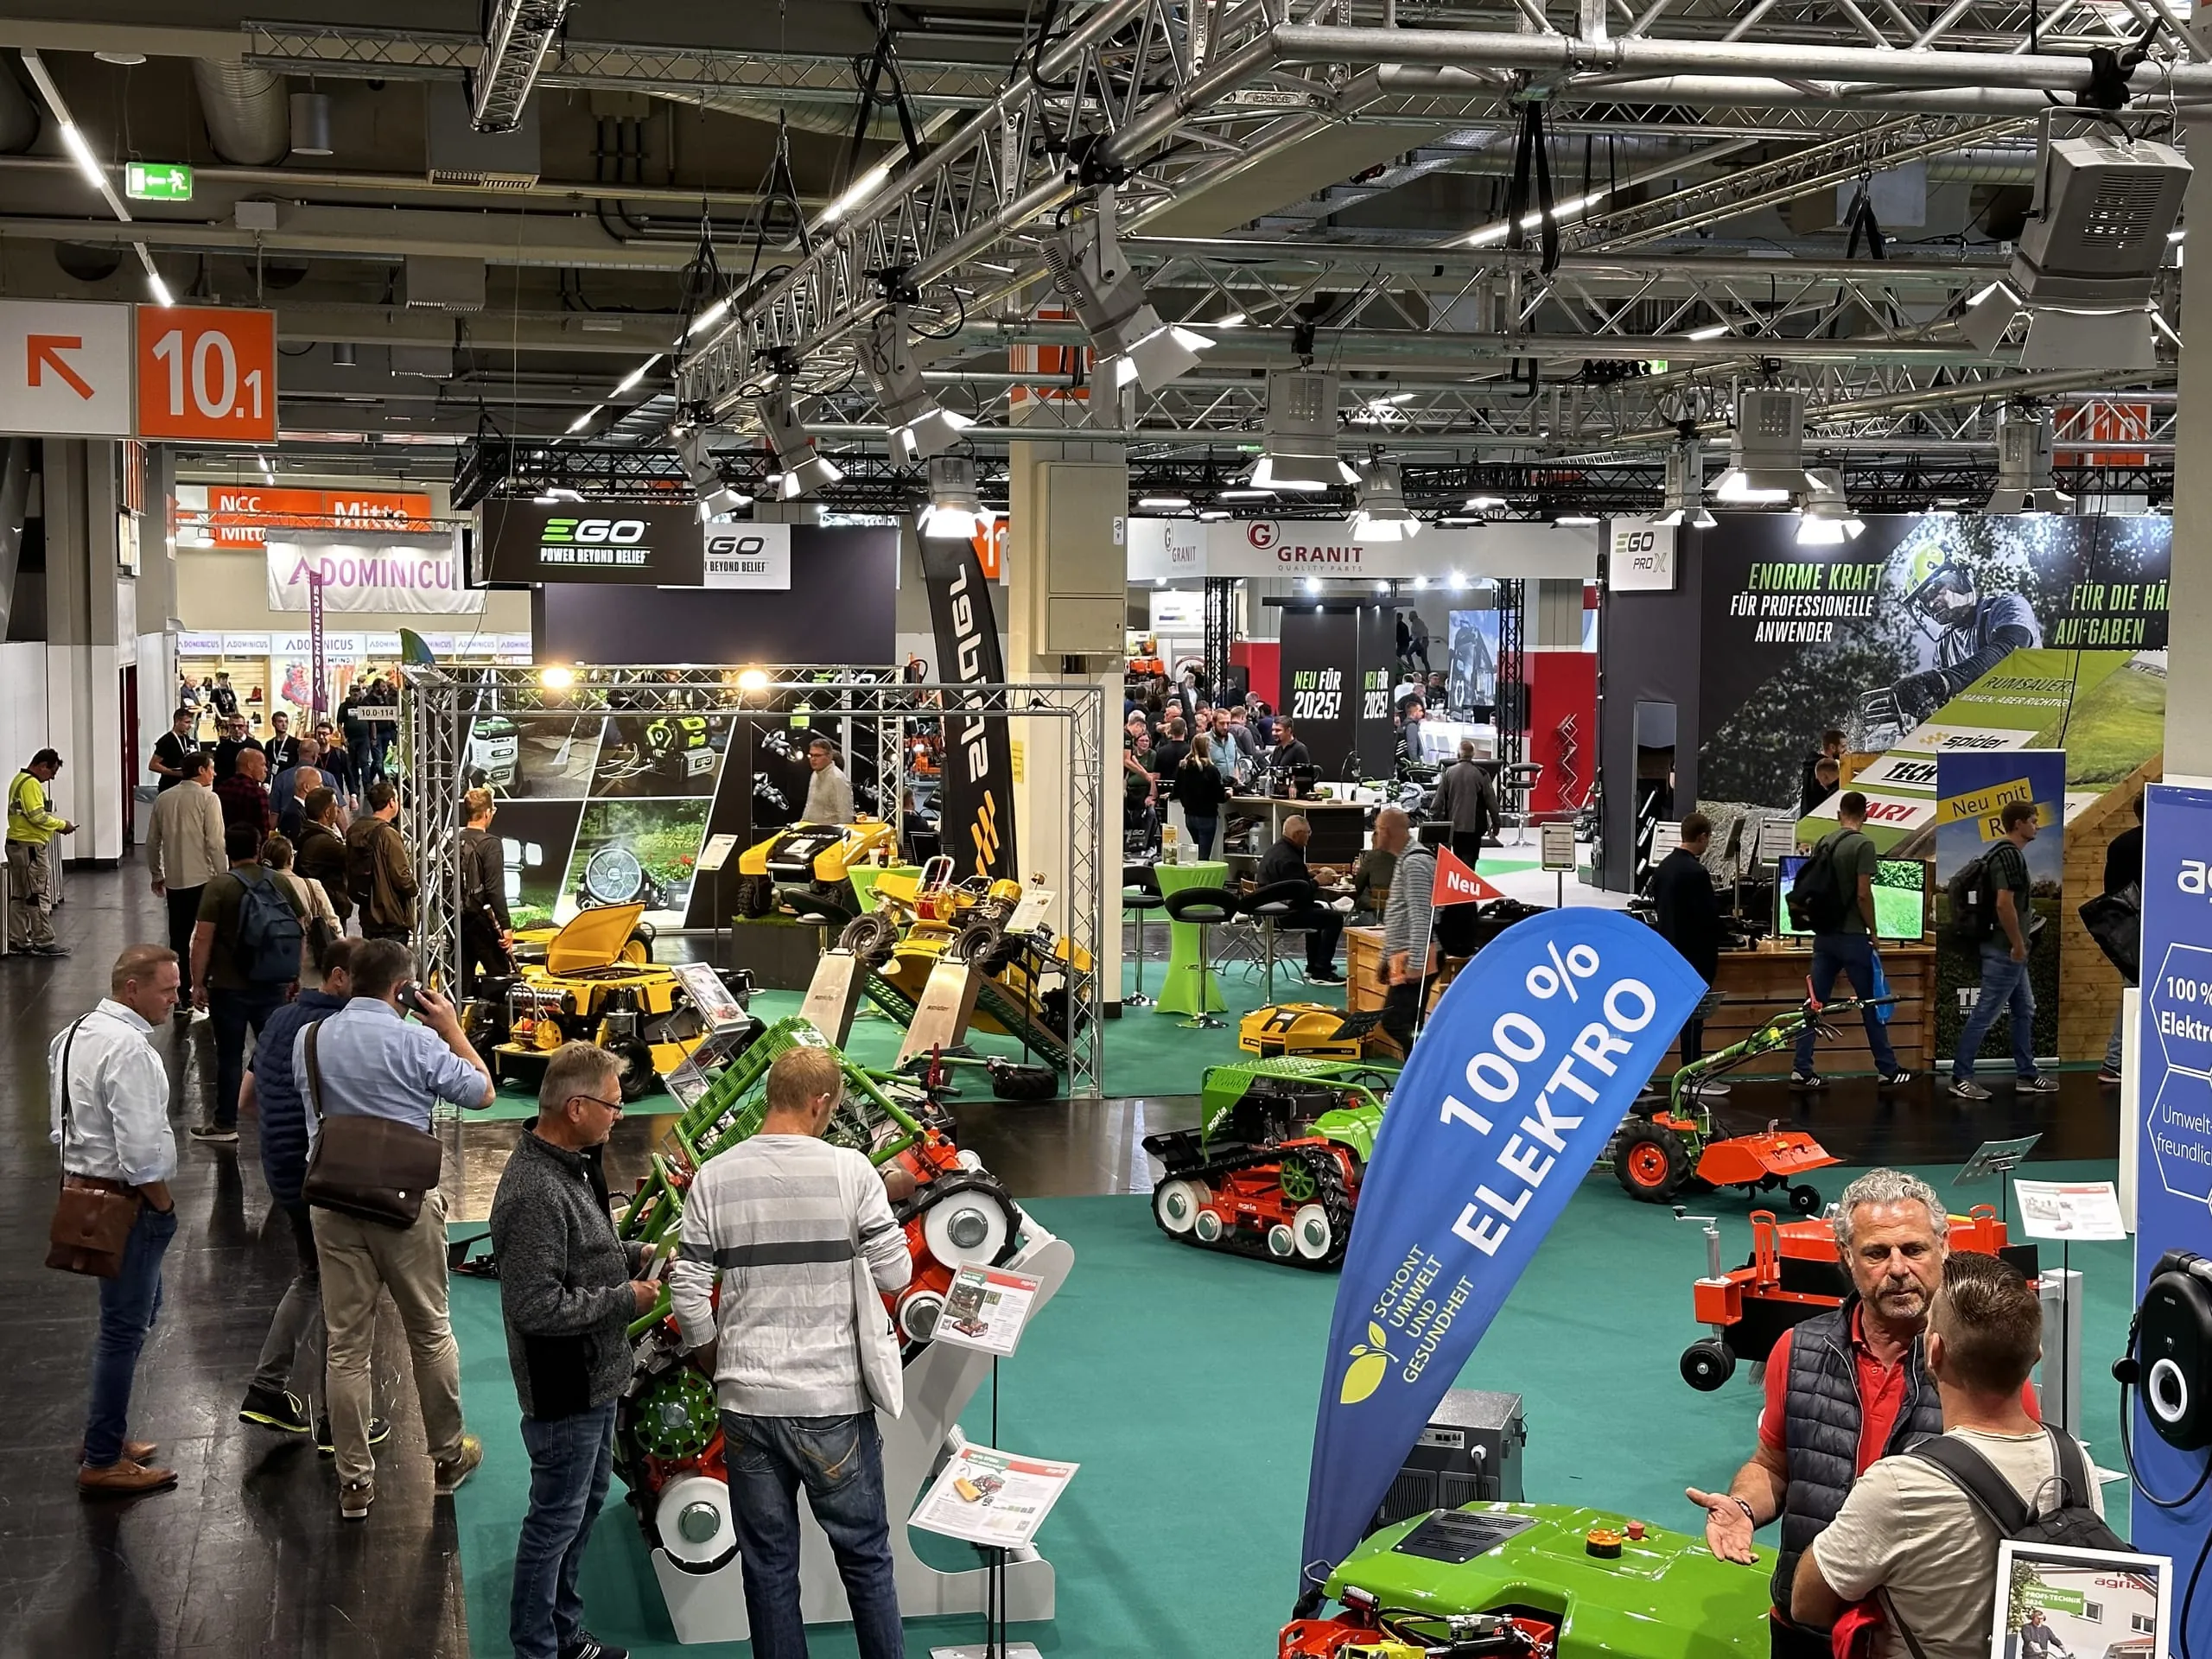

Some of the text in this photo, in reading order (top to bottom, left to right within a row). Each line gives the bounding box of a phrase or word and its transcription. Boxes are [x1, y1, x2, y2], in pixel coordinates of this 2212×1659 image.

[152, 329, 262, 419] 10.1
[220, 495, 261, 512] NCC
[221, 527, 266, 541] Mitt
[541, 518, 645, 543] EGO
[1615, 531, 1655, 553] EGO
[540, 547, 646, 564] POWER BEYOND BELIEF
[705, 536, 765, 555] GO
[1173, 546, 1196, 563] GRANIT
[1277, 546, 1363, 563] GRANIT
[709, 562, 740, 572] BEYOND
[741, 562, 766, 573] BELIEF
[1748, 563, 1885, 591] ENORME KRAFT
[1730, 591, 1875, 617] FÜR PROFESSIONELLE
[2070, 579, 2105, 611] FÜR
[2109, 584, 2139, 611] DIE
[1754, 621, 1833, 643] ANWENDER
[2054, 618, 2145, 645] AUFGABEN
[1294, 666, 1341, 690] NEU FÜR
[1364, 666, 1389, 690] NEU FÜR
[1981, 677, 2074, 692] RUMSAUER
[361, 709, 394, 717] 10.0-114
[1293, 691, 1342, 720] 2025!
[1363, 691, 1389, 719] 2025!
[1942, 734, 2011, 749] spider
[1953, 785, 2028, 818] Neu mit
[1446, 870, 1480, 897] Neu
[2166, 976, 2196, 1002] 100
[1439, 939, 1600, 1136] 100 %
[1207, 1105, 1228, 1131] agria
[1451, 978, 1656, 1256] ELEKTRO
[2162, 1103, 2212, 1135] Umwelt-
[2157, 1132, 2212, 1166] freundlic
[1237, 1202, 1256, 1211] agria
[1373, 1243, 1425, 1318] SCHONT
[1389, 1254, 1443, 1328] UMWELT
[1402, 1274, 1474, 1383] GESUNDHEIT
[1405, 1299, 1437, 1338] UND
[2094, 1577, 2144, 1590] agria
